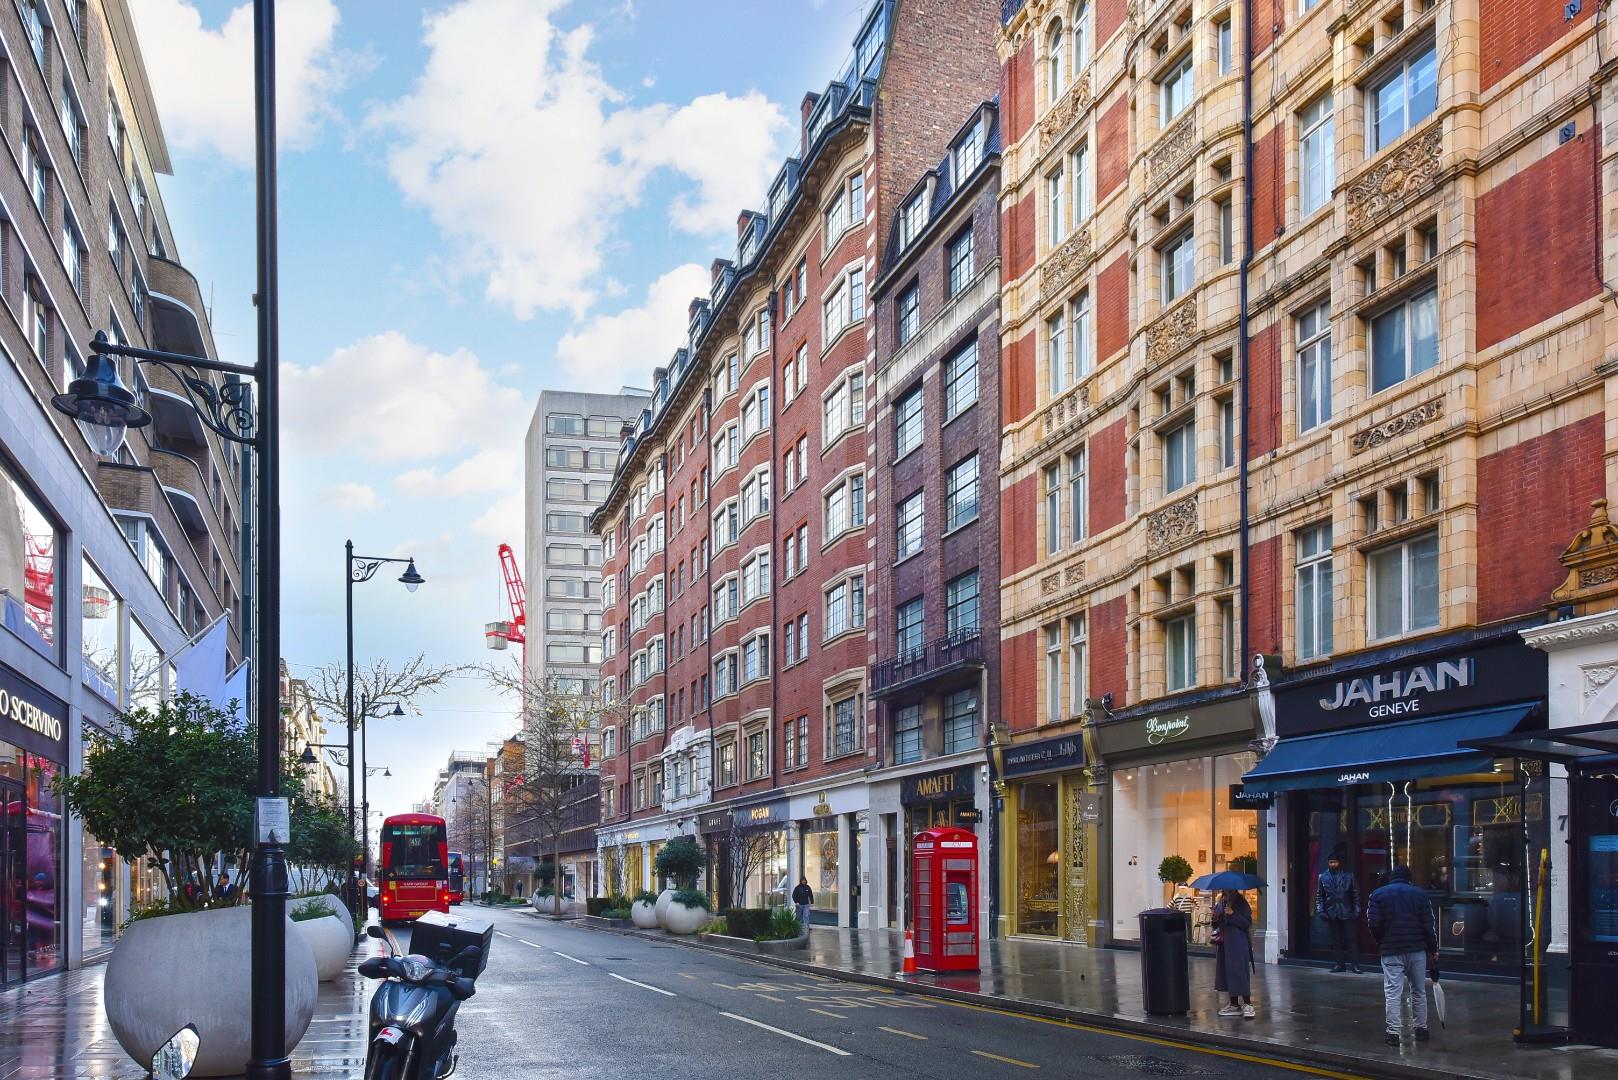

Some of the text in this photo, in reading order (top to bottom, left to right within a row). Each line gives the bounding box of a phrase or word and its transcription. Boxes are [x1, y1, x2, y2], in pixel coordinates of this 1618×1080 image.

[1319, 657, 1470, 711] JAHAN
[1369, 699, 1420, 718] GENEVE
[10, 695, 62, 742] SCERVINO
[1337, 772, 1370, 782] JAHAN
[1235, 791, 1269, 799] JAHAN
